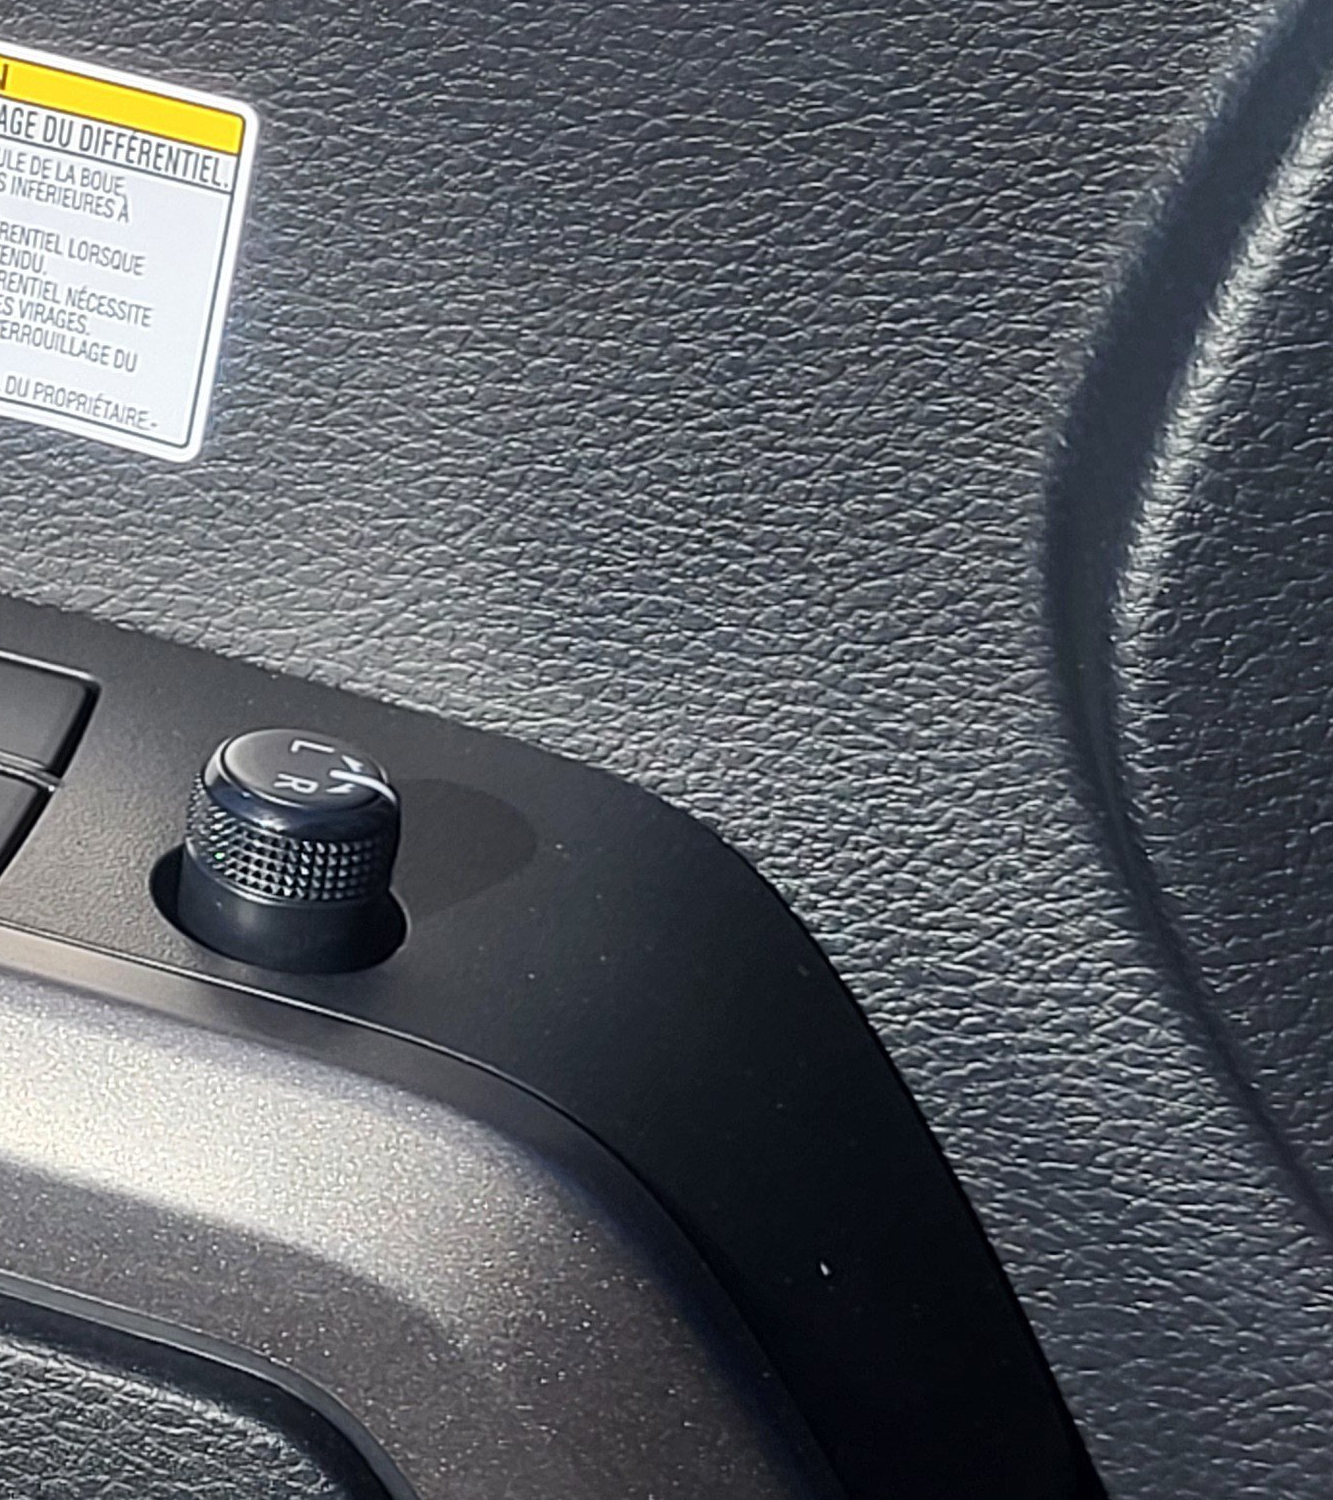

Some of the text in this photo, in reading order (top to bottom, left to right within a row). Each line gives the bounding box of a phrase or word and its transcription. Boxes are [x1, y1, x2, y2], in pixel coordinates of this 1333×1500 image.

[41, 114, 74, 148] DU
[78, 116, 234, 188] DIFFÉRENTIEL.
[28, 154, 53, 179] DE
[54, 160, 75, 185] LA
[67, 237, 145, 276] LORSQUE
[112, 347, 138, 373] DU
[3, 374, 30, 398] DU
[290, 738, 334, 754] L
[273, 772, 319, 796] R
